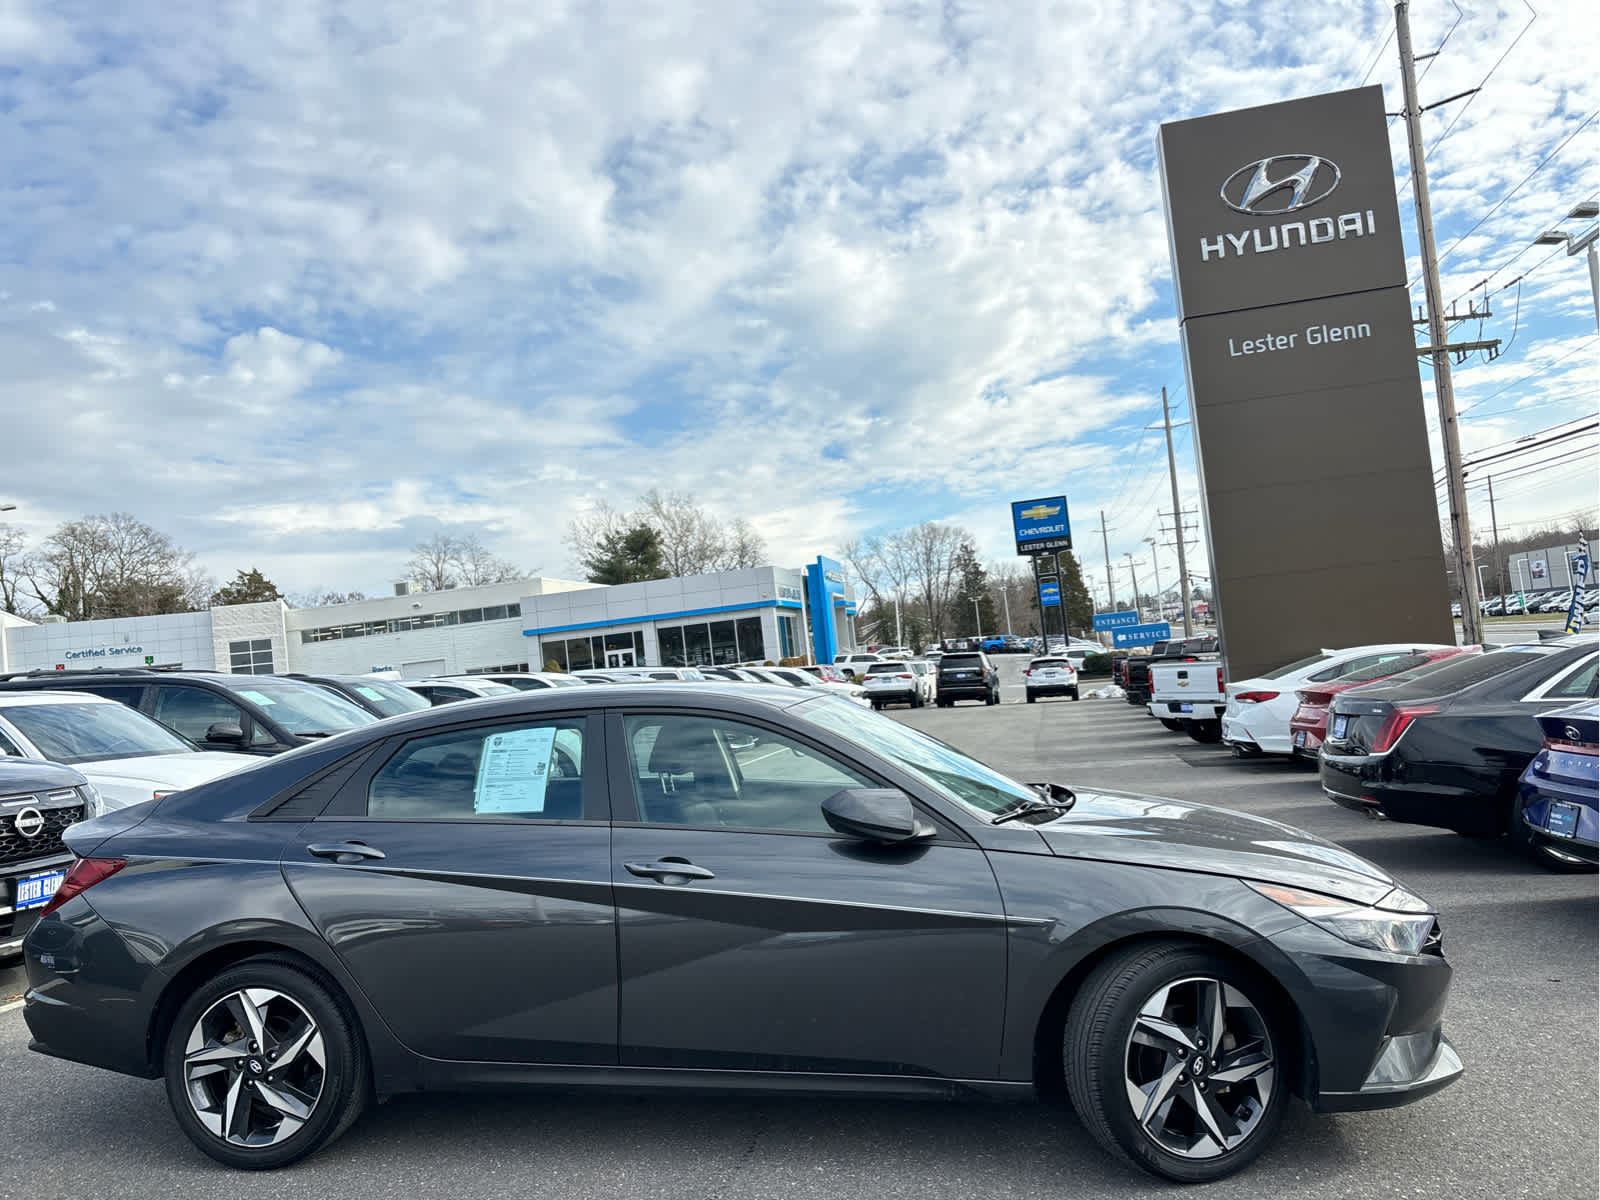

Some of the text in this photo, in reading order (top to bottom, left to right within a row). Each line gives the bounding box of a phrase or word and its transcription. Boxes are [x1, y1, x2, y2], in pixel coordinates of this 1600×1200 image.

[1200, 210, 1376, 261] HYUNDAI
[1228, 322, 1372, 357] Lester Glenn
[1019, 524, 1065, 536] CHEVROLET
[1020, 540, 1069, 551] LESTER GLENN
[1095, 616, 1138, 627] ENTRANCE
[1128, 629, 1169, 640] SERVICE
[65, 646, 143, 659] Certified Service
[17, 880, 42, 902] LESTER
